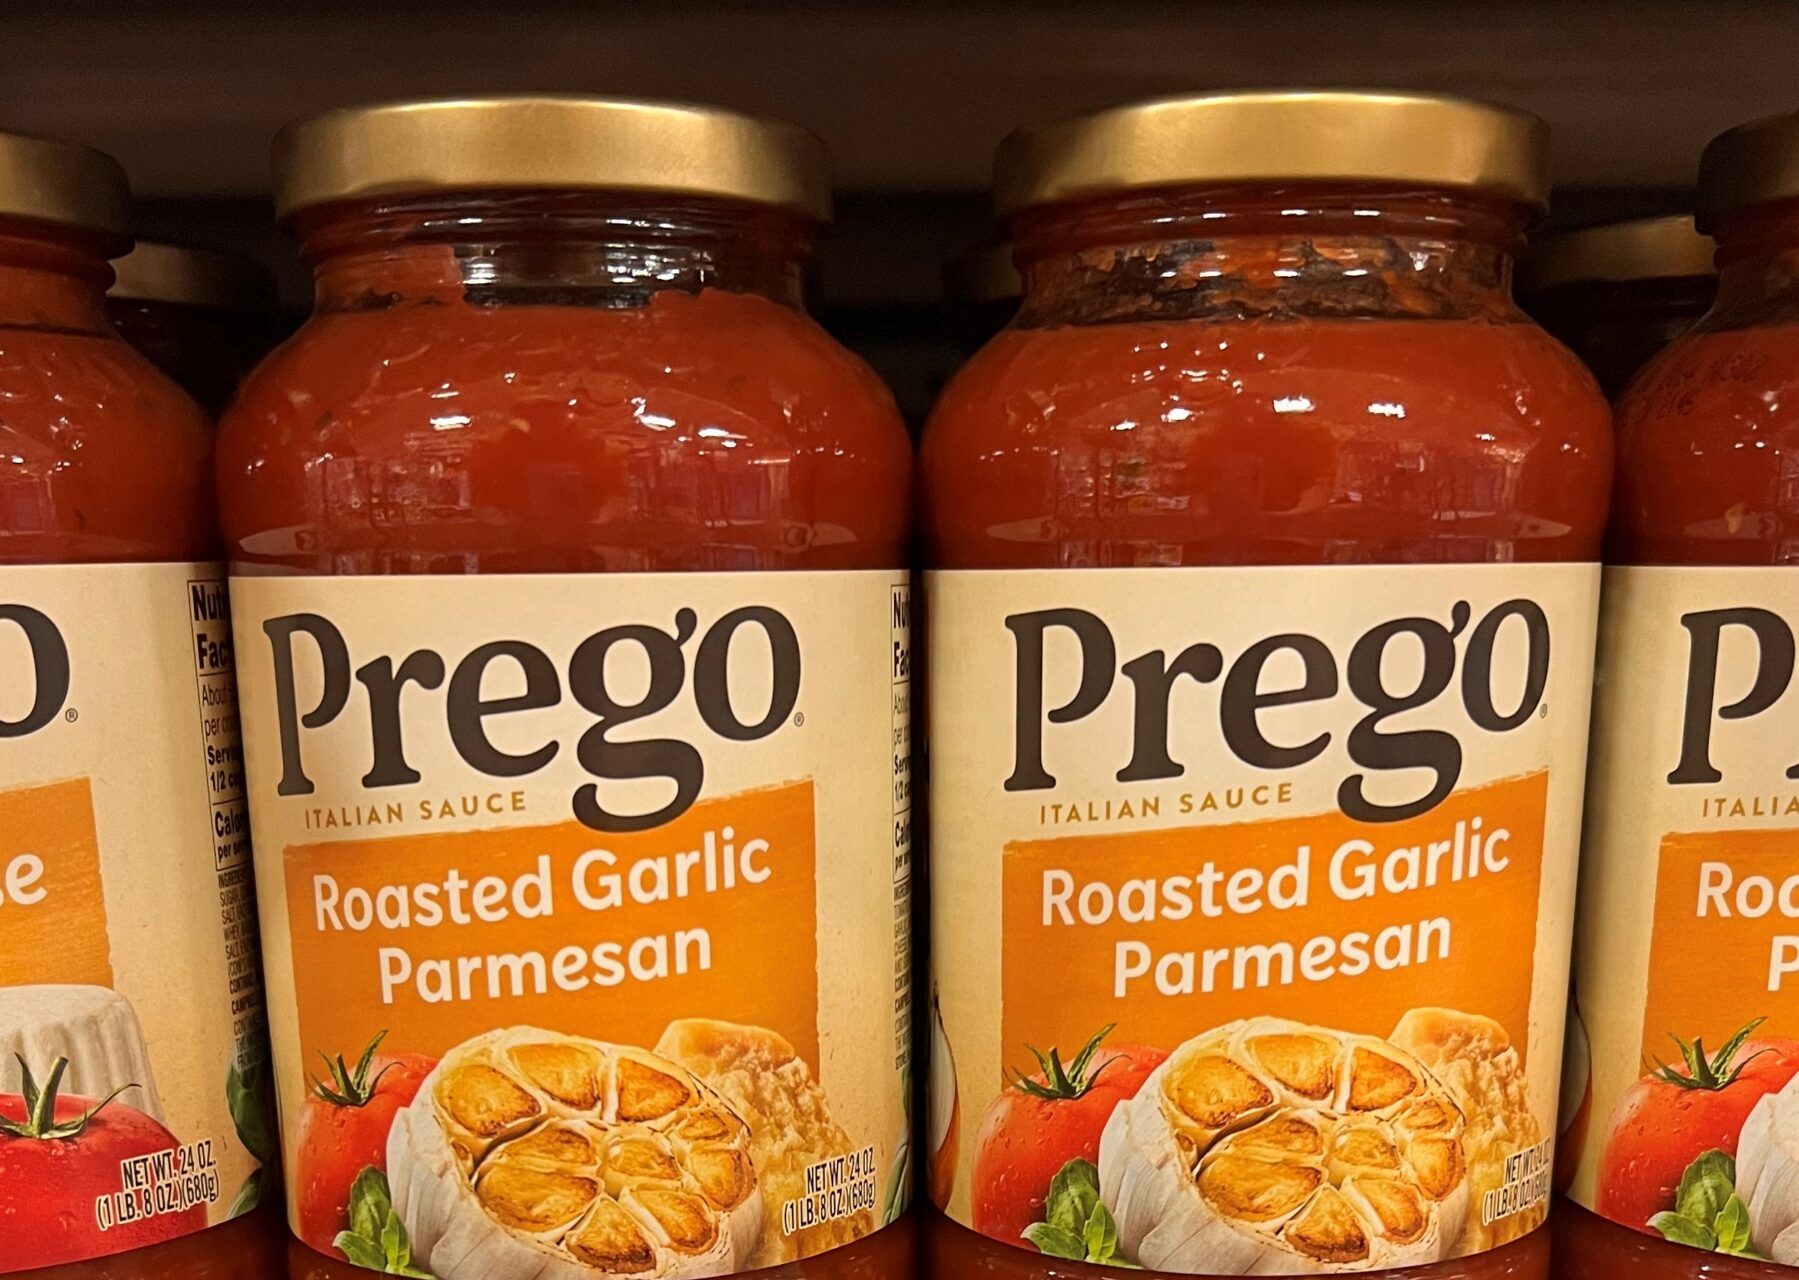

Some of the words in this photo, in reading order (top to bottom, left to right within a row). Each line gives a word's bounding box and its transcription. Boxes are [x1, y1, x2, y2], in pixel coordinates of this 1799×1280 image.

[196, 633, 232, 669] Fac
[263, 605, 800, 833] Prego
[1004, 599, 1550, 823] Prego
[210, 769, 226, 793] 1/2
[1040, 796, 1160, 825] ITALIAN
[1180, 782, 1293, 813] SAUCE
[305, 801, 403, 829] ITALIAN
[421, 790, 526, 820] SAUCE
[1702, 797, 1799, 818] ITALIA
[313, 854, 551, 931] Roasted
[573, 825, 772, 910] Garlic
[1042, 845, 1309, 926] Roasted
[1329, 816, 1510, 900] Garlic
[380, 928, 712, 1004] Parmesan
[1114, 915, 1451, 998] Parmesan
[123, 1157, 149, 1189] NET
[152, 1152, 177, 1182] WT.
[179, 1146, 195, 1175] 24
[197, 1140, 216, 1169] OZ.
[807, 1162, 827, 1194] NET
[829, 1157, 847, 1187] WT.
[849, 1152, 860, 1181] 24
[862, 1146, 876, 1176] OZ.
[1505, 1154, 1522, 1185] NET
[97, 1197, 112, 1229] (1
[116, 1192, 141, 1222] LB.
[143, 1189, 153, 1215] 8
[784, 1201, 795, 1234] (1
[799, 1198, 817, 1227] LB.
[820, 1194, 827, 1221] 8
